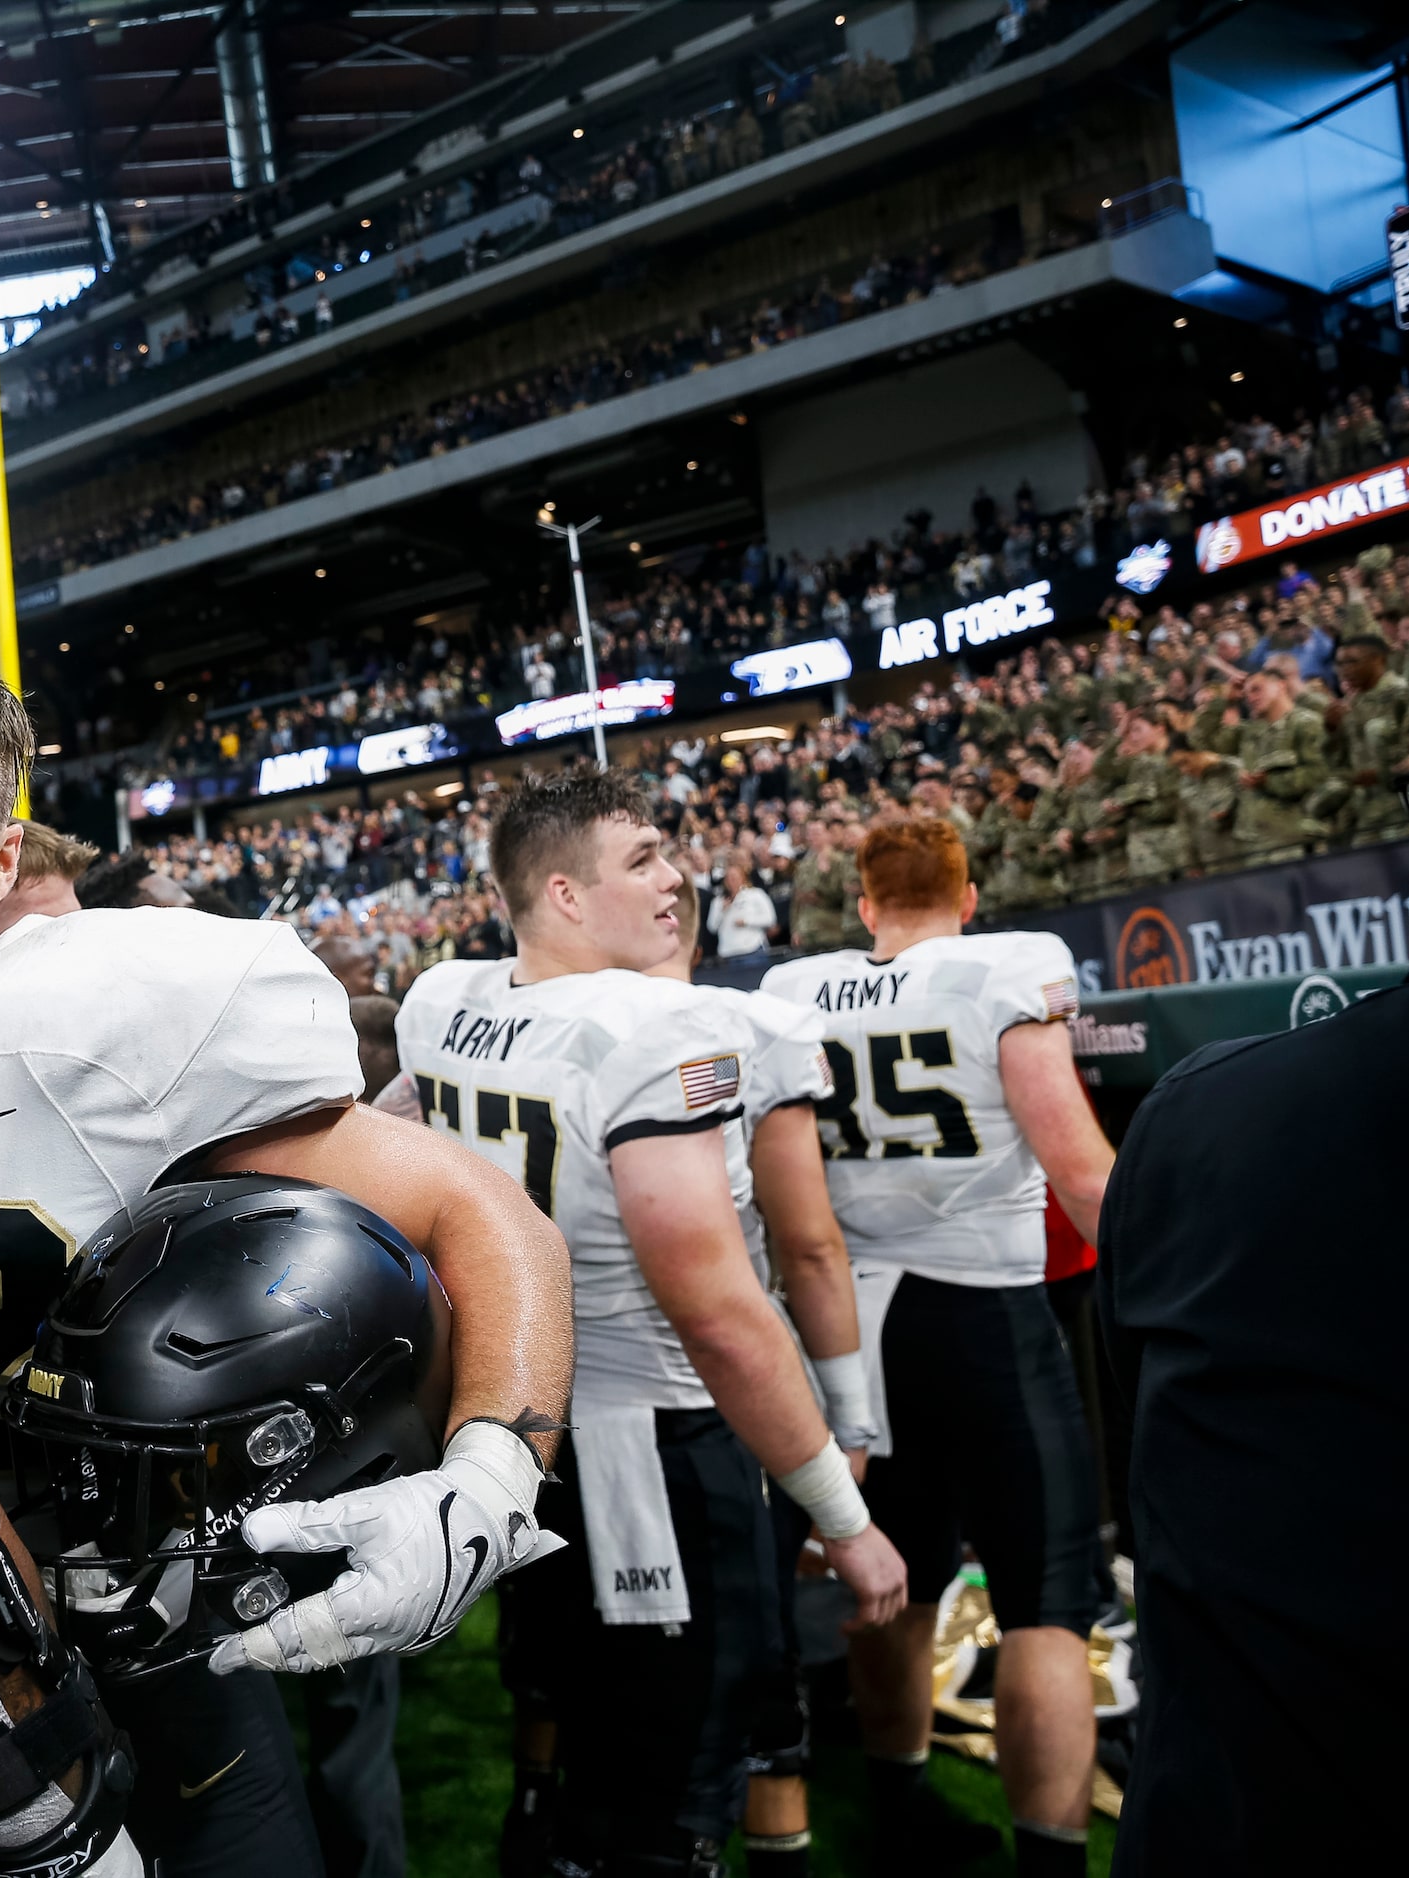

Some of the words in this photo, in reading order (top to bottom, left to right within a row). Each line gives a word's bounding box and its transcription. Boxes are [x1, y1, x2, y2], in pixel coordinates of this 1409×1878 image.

[1260, 466, 1408, 546] DONATE
[879, 618, 939, 670] AIR
[943, 580, 1054, 653] FORCE
[259, 746, 329, 795] ARMY
[1188, 920, 1313, 984] Evan
[1305, 892, 1409, 972] Wil
[815, 970, 911, 1012] ARMY
[441, 1009, 532, 1061] ARMY
[27, 1367, 66, 1399] ARMY
[614, 1565, 673, 1593] ARMY
